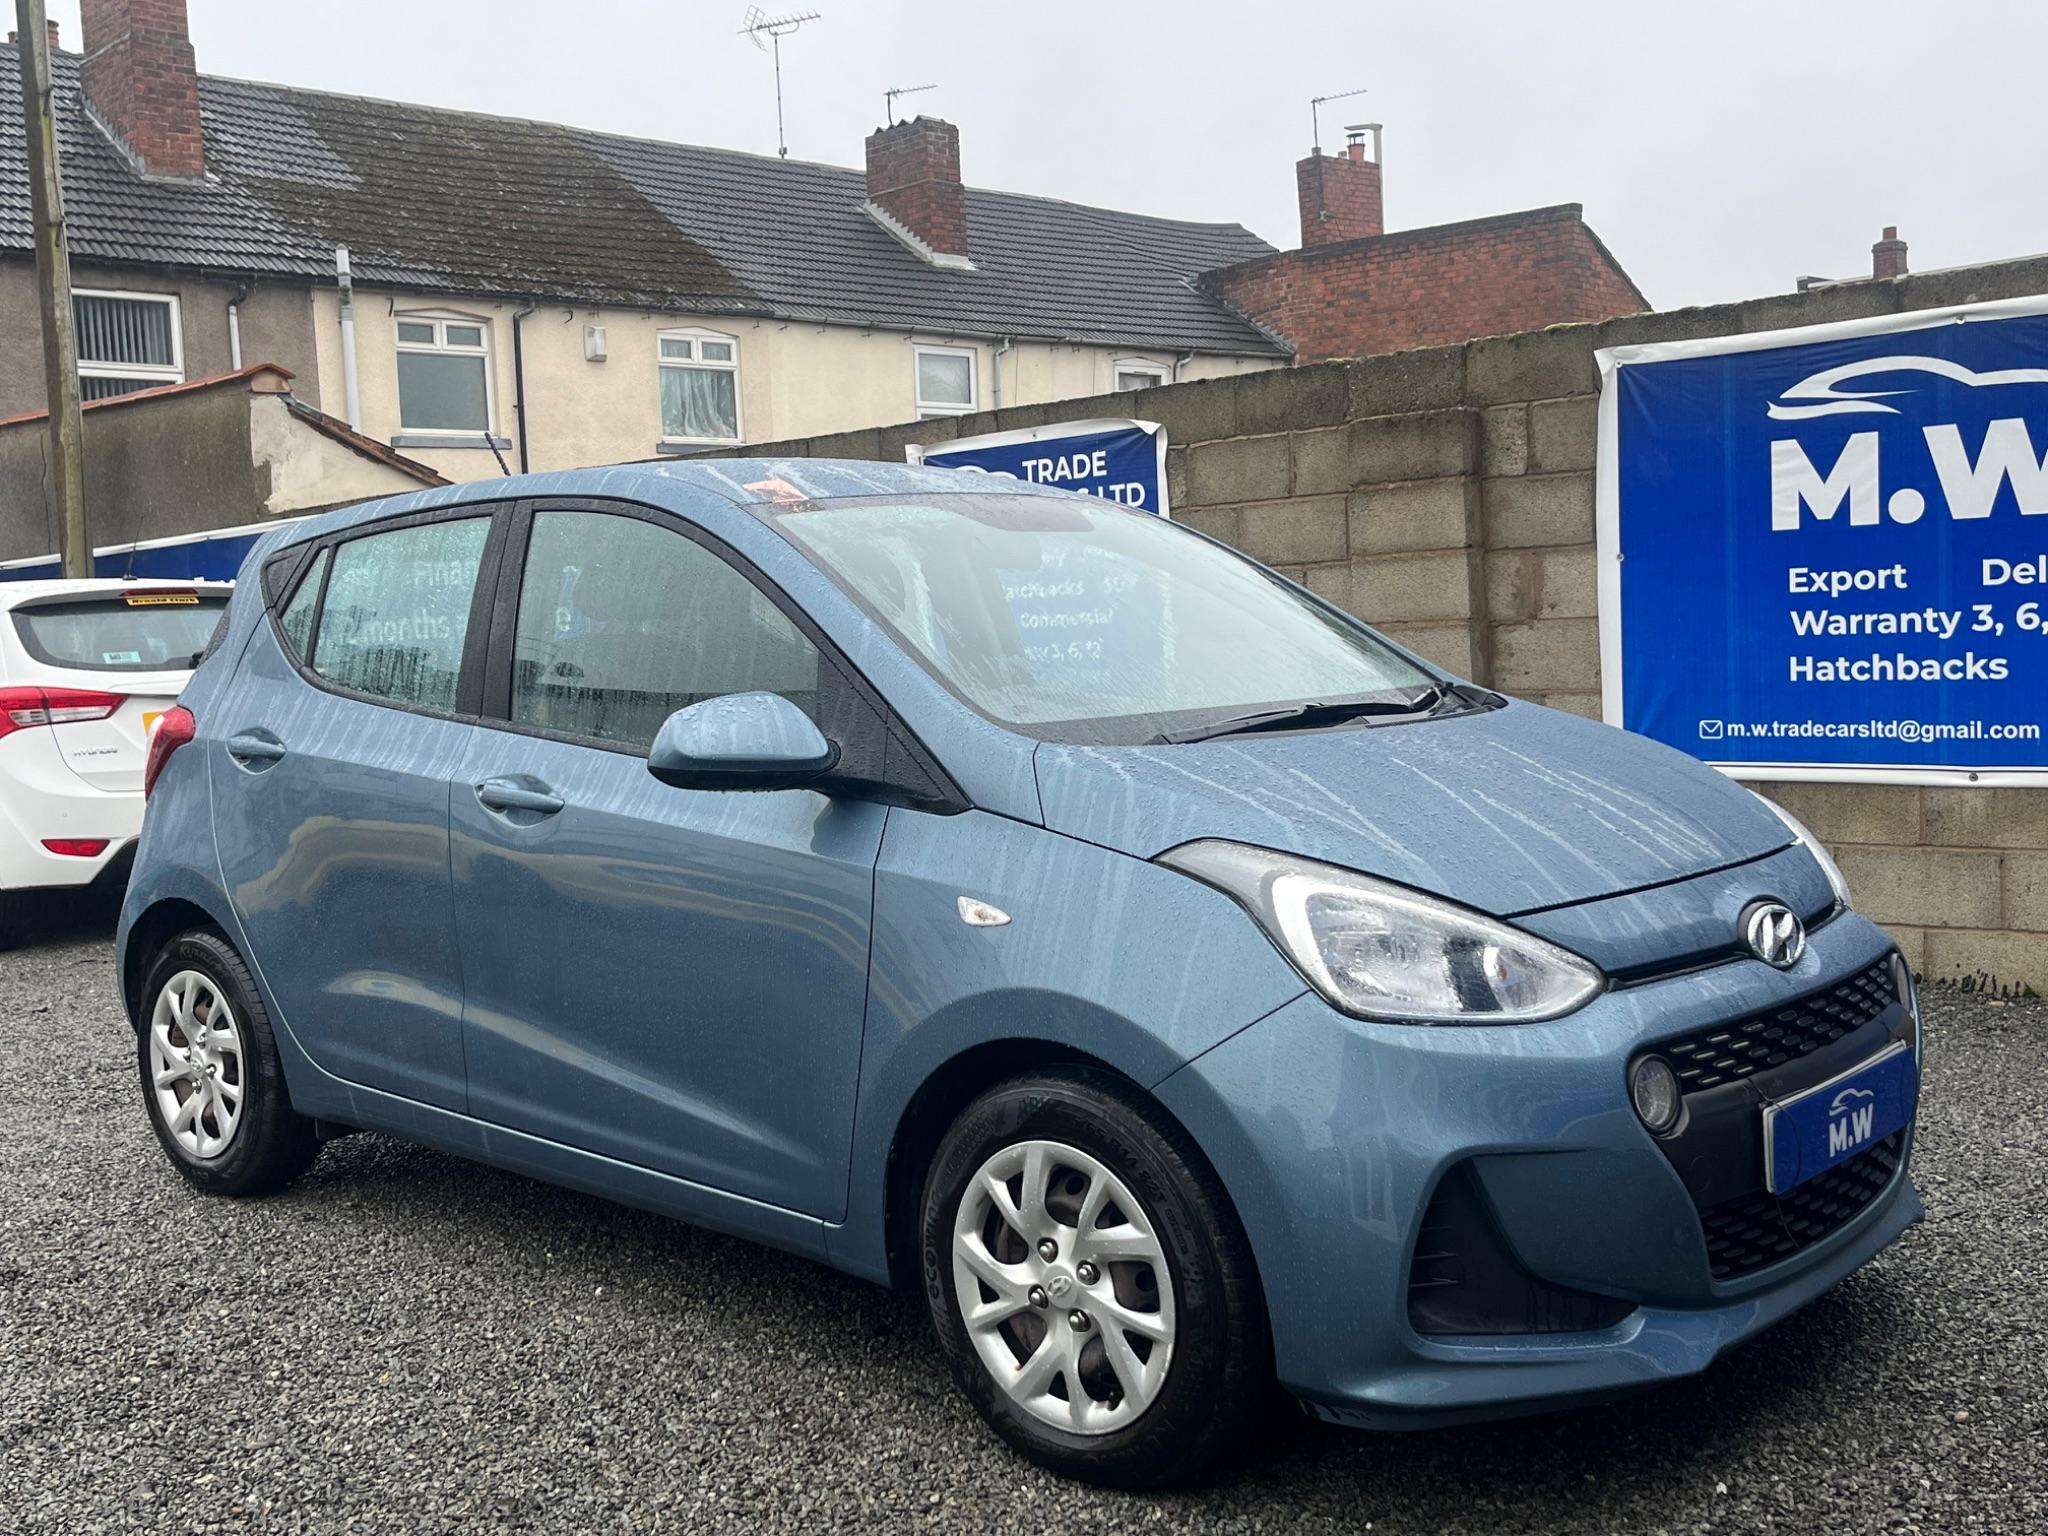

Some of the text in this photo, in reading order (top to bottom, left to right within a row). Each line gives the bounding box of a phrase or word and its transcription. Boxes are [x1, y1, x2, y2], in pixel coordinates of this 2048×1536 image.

[1022, 450, 1108, 483] TRADE
[1789, 554, 2047, 598] Export Del
[1790, 607, 1962, 640] Warranty
[1971, 604, 2004, 636] 3,
[1790, 651, 2009, 682] Hatchbacks
[1727, 719, 2040, 743] m.w.tradecarsltd@gmail.com
[1829, 1103, 1874, 1158] M.W
